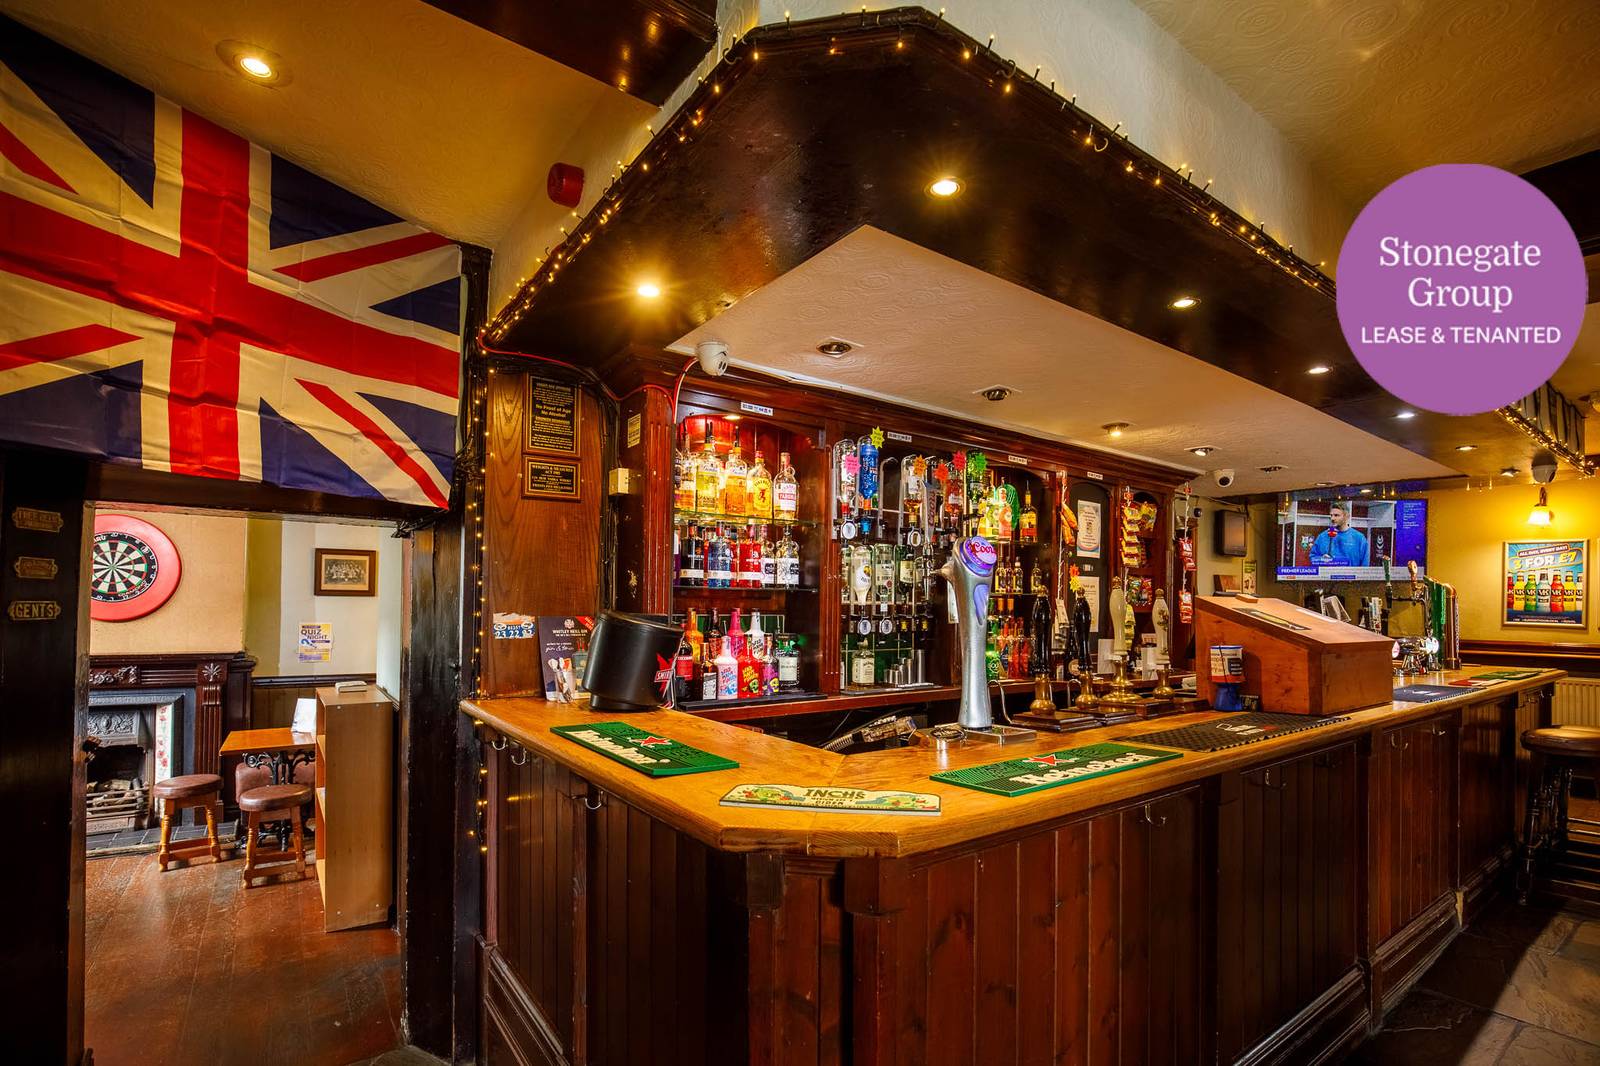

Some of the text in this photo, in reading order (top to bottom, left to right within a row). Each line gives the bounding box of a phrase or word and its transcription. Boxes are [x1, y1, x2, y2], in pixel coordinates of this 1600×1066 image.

[1525, 555, 1555, 567] FOR
[1558, 551, 1577, 563] £7
[15, 603, 54, 618] GENTS
[1009, 752, 1160, 785] Heineken
